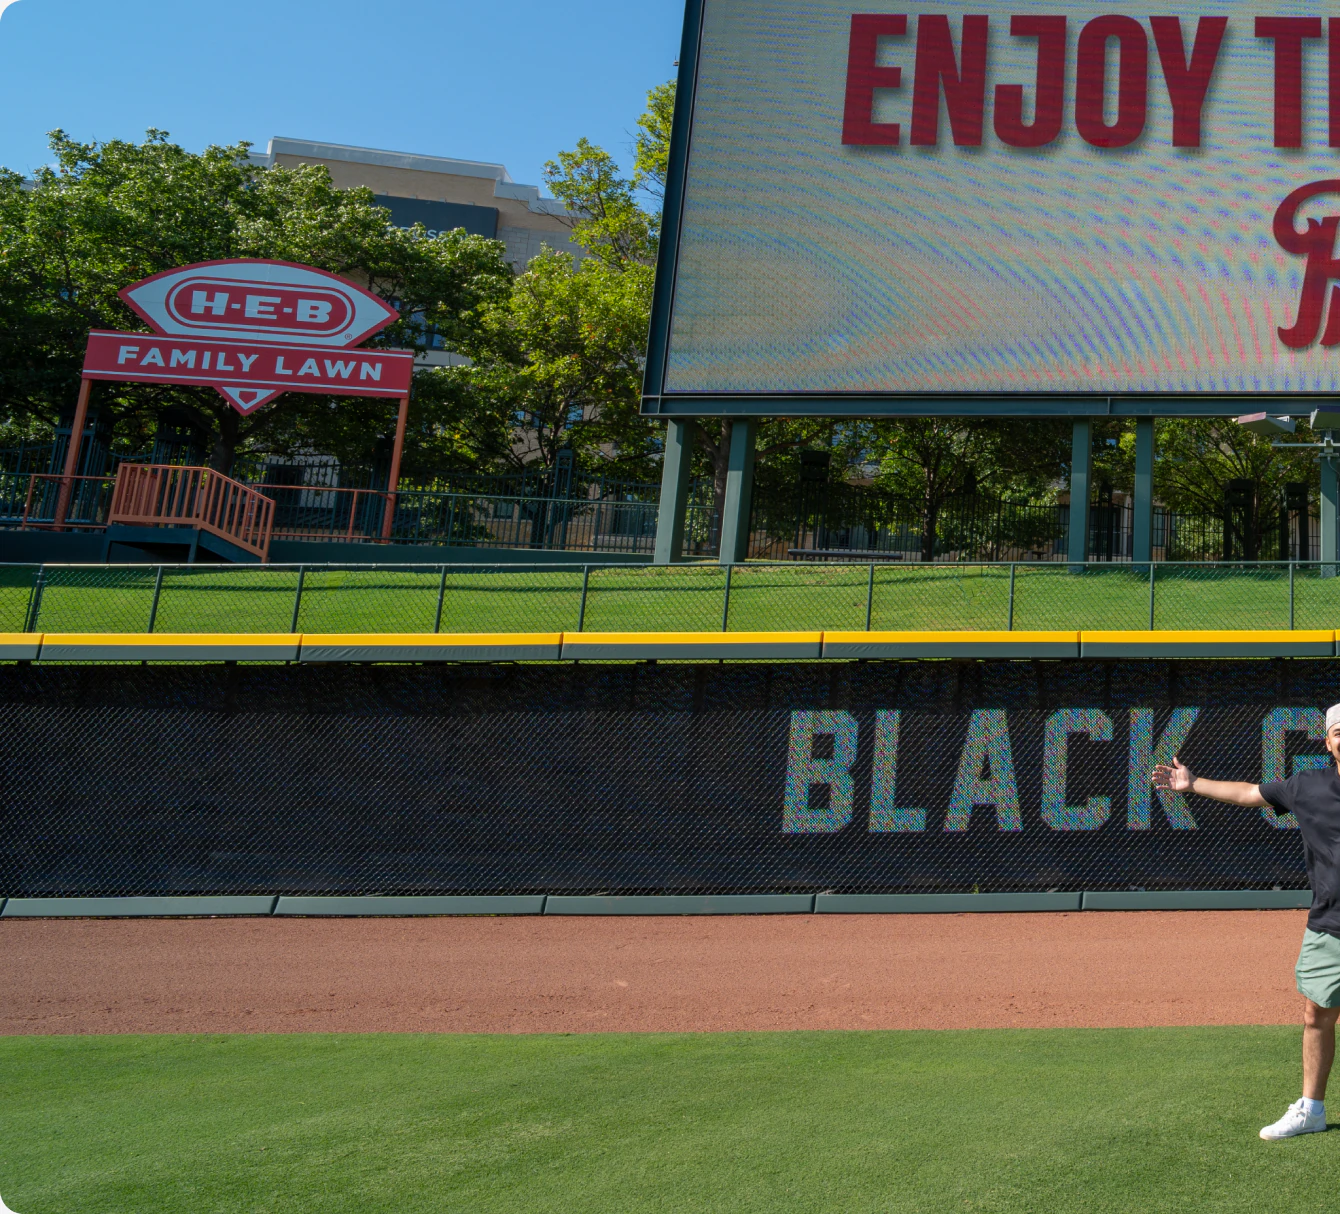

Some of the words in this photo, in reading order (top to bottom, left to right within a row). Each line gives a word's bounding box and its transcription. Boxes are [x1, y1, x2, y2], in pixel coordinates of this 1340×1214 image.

[841, 13, 1229, 149] ENJOY
[190, 290, 333, 323] H-E-B
[117, 345, 259, 372] FAMILY
[274, 356, 383, 381] LAWN
[782, 708, 1200, 833] BLACK
